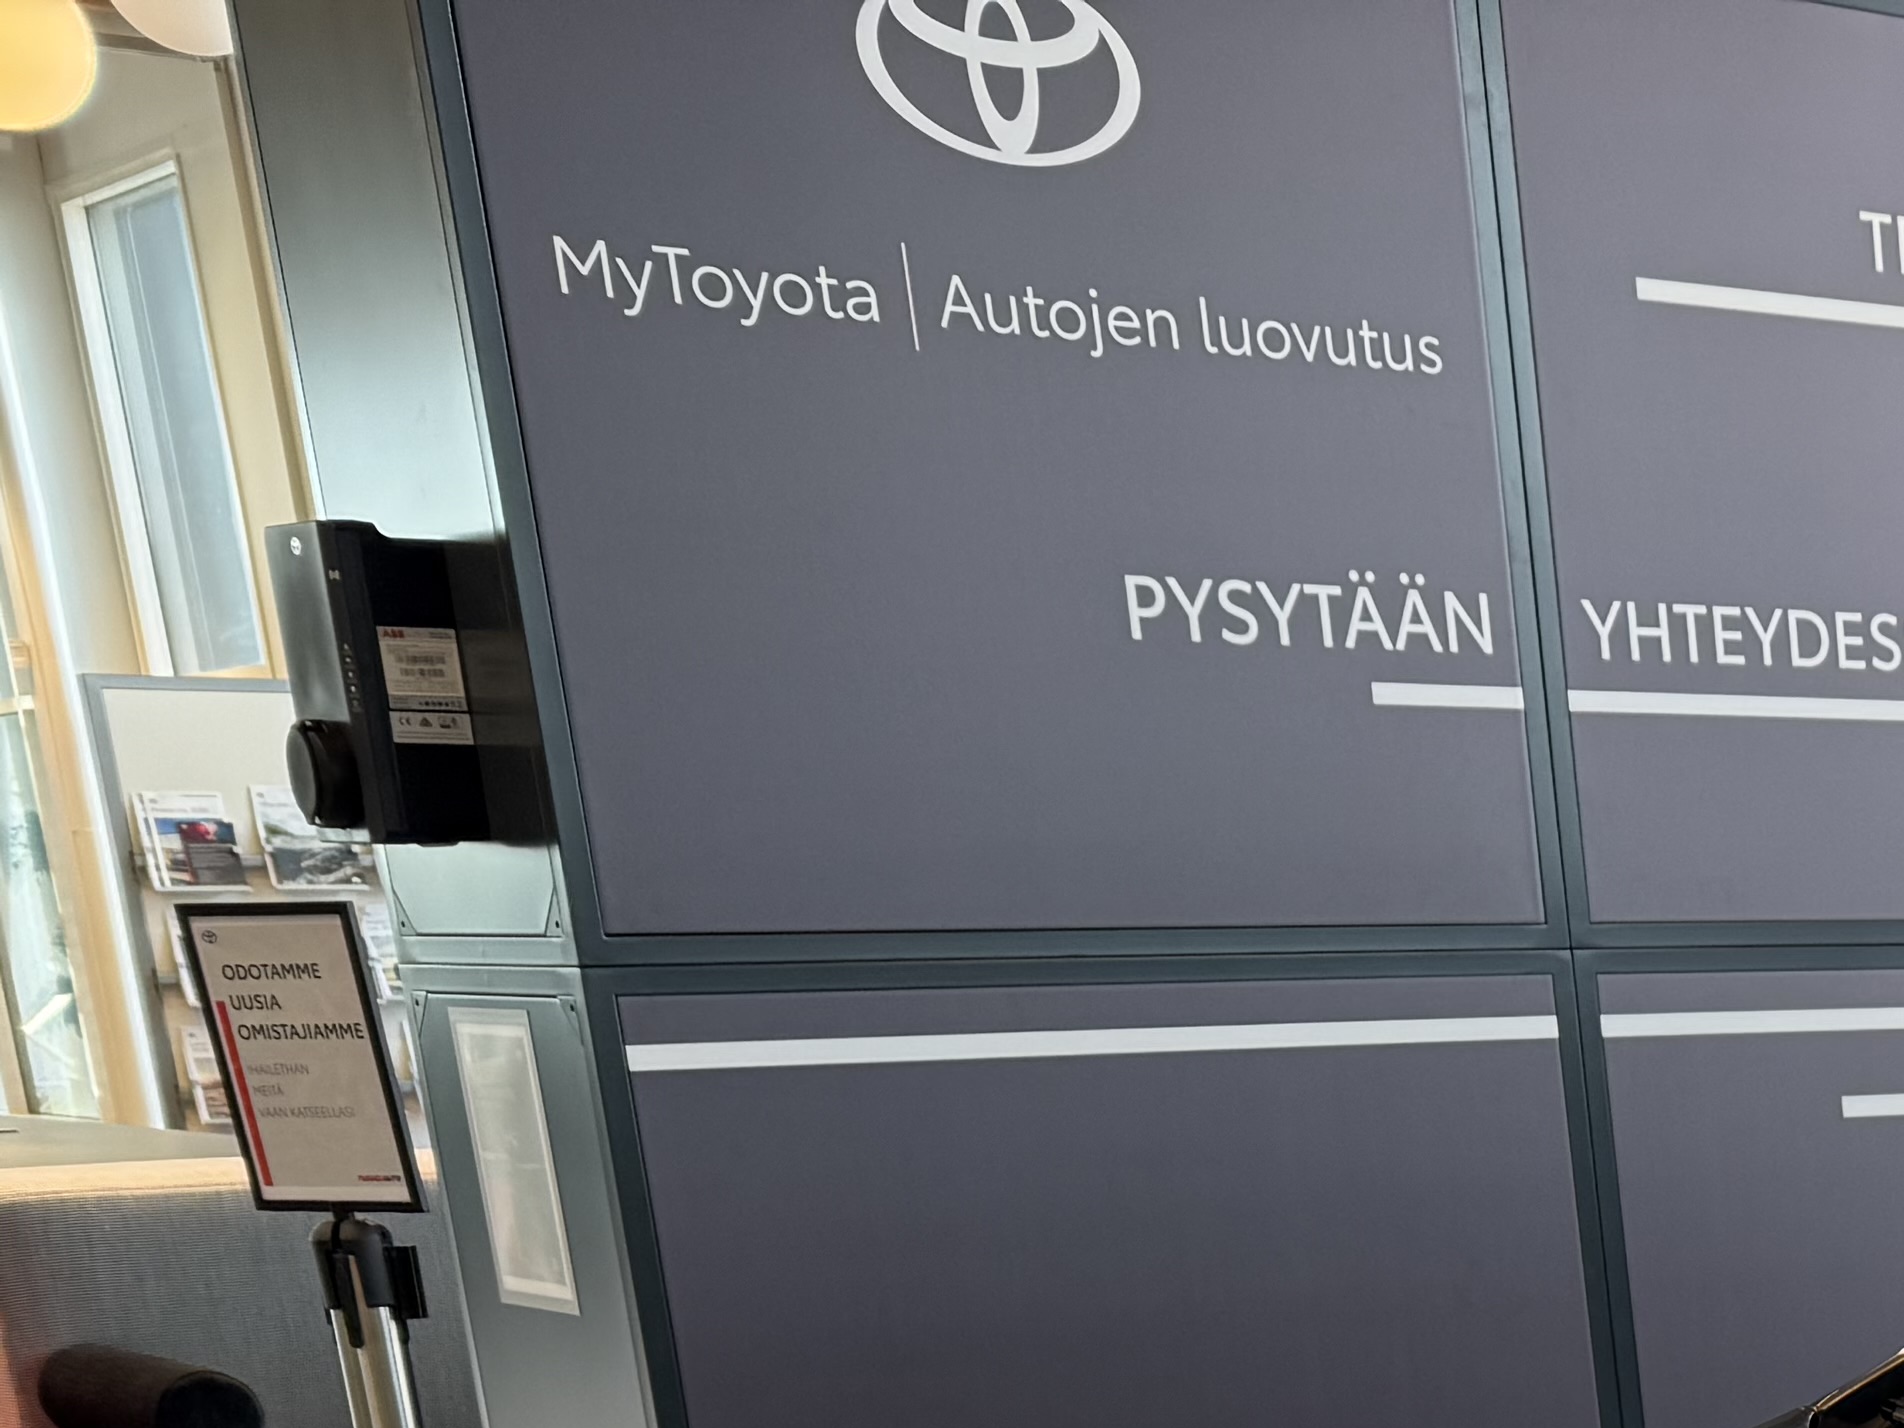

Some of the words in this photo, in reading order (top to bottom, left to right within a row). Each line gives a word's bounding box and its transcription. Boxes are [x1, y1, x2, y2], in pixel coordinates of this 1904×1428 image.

[552, 235, 881, 327] MyToyota
[940, 274, 1180, 358] Autojen
[1199, 296, 1443, 375] luovutus
[1124, 569, 1494, 655] PYSYTÄÄN
[221, 962, 322, 981] ODOTAMME
[228, 993, 283, 1011] UUSIA
[237, 1022, 365, 1041] OMISTAJIAMME
